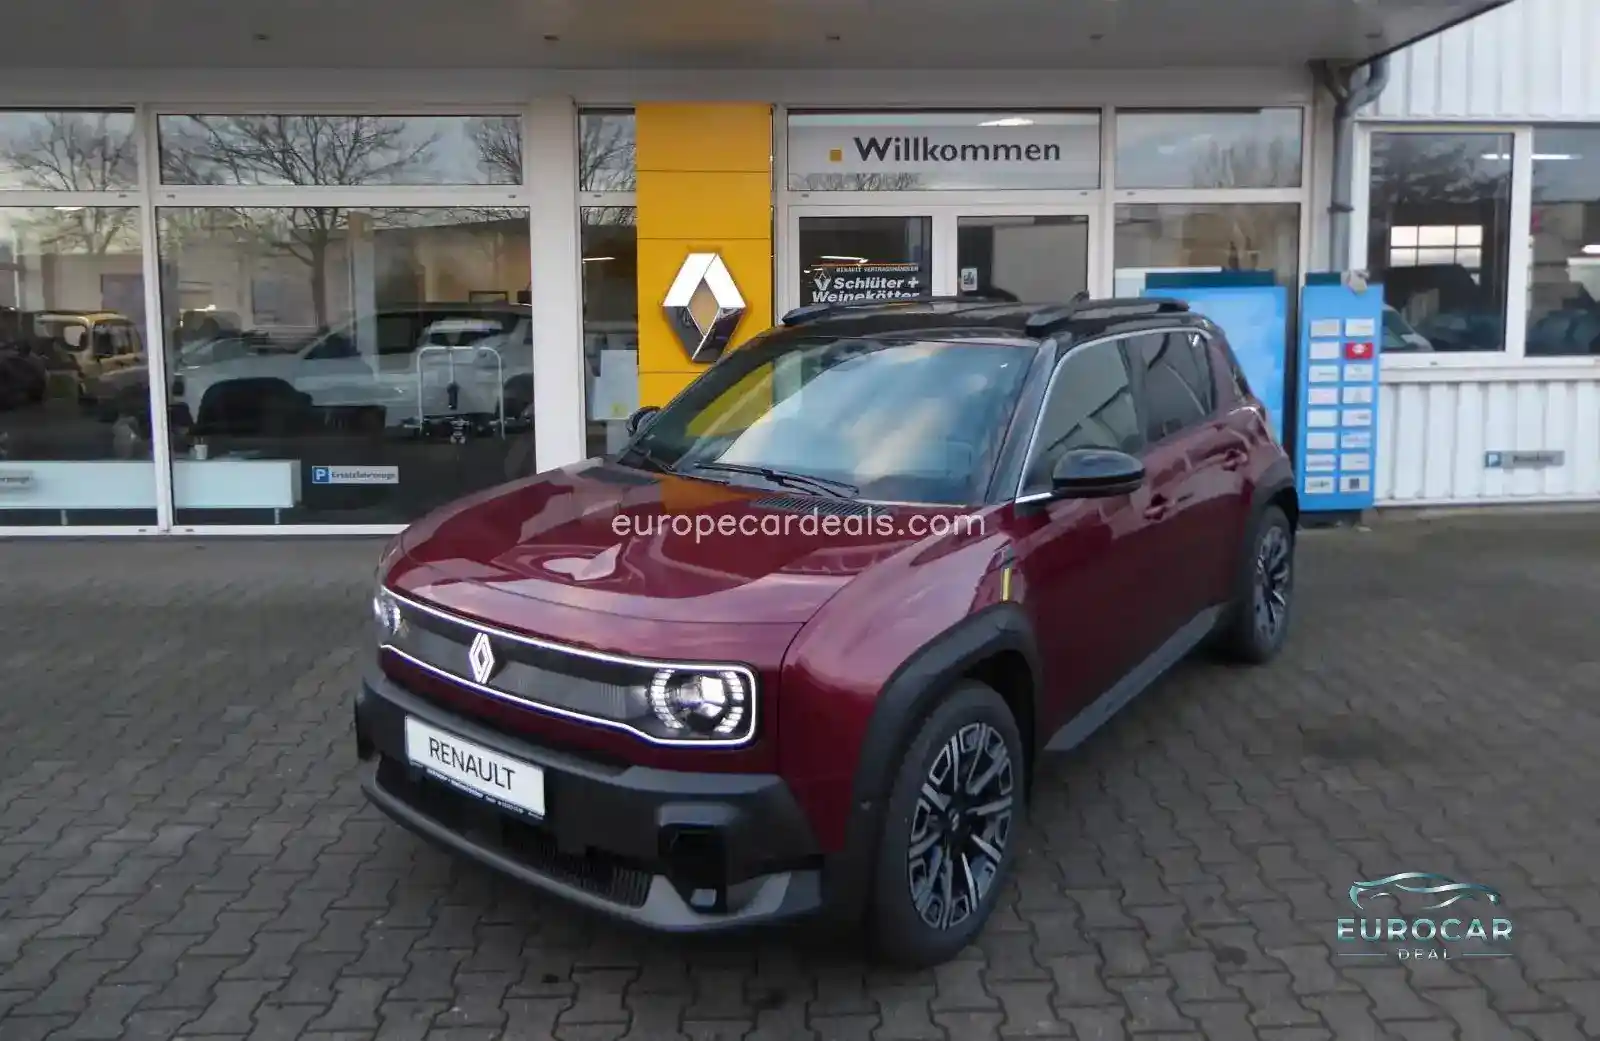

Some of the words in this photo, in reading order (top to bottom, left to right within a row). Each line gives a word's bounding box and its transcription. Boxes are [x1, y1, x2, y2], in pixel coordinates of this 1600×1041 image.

[852, 136, 1061, 162] Willkommen
[833, 276, 905, 290] Schlüter
[907, 277, 919, 289] +
[812, 290, 920, 303] Weinekötter
[315, 468, 327, 481] P
[428, 736, 516, 790] RENAULT
